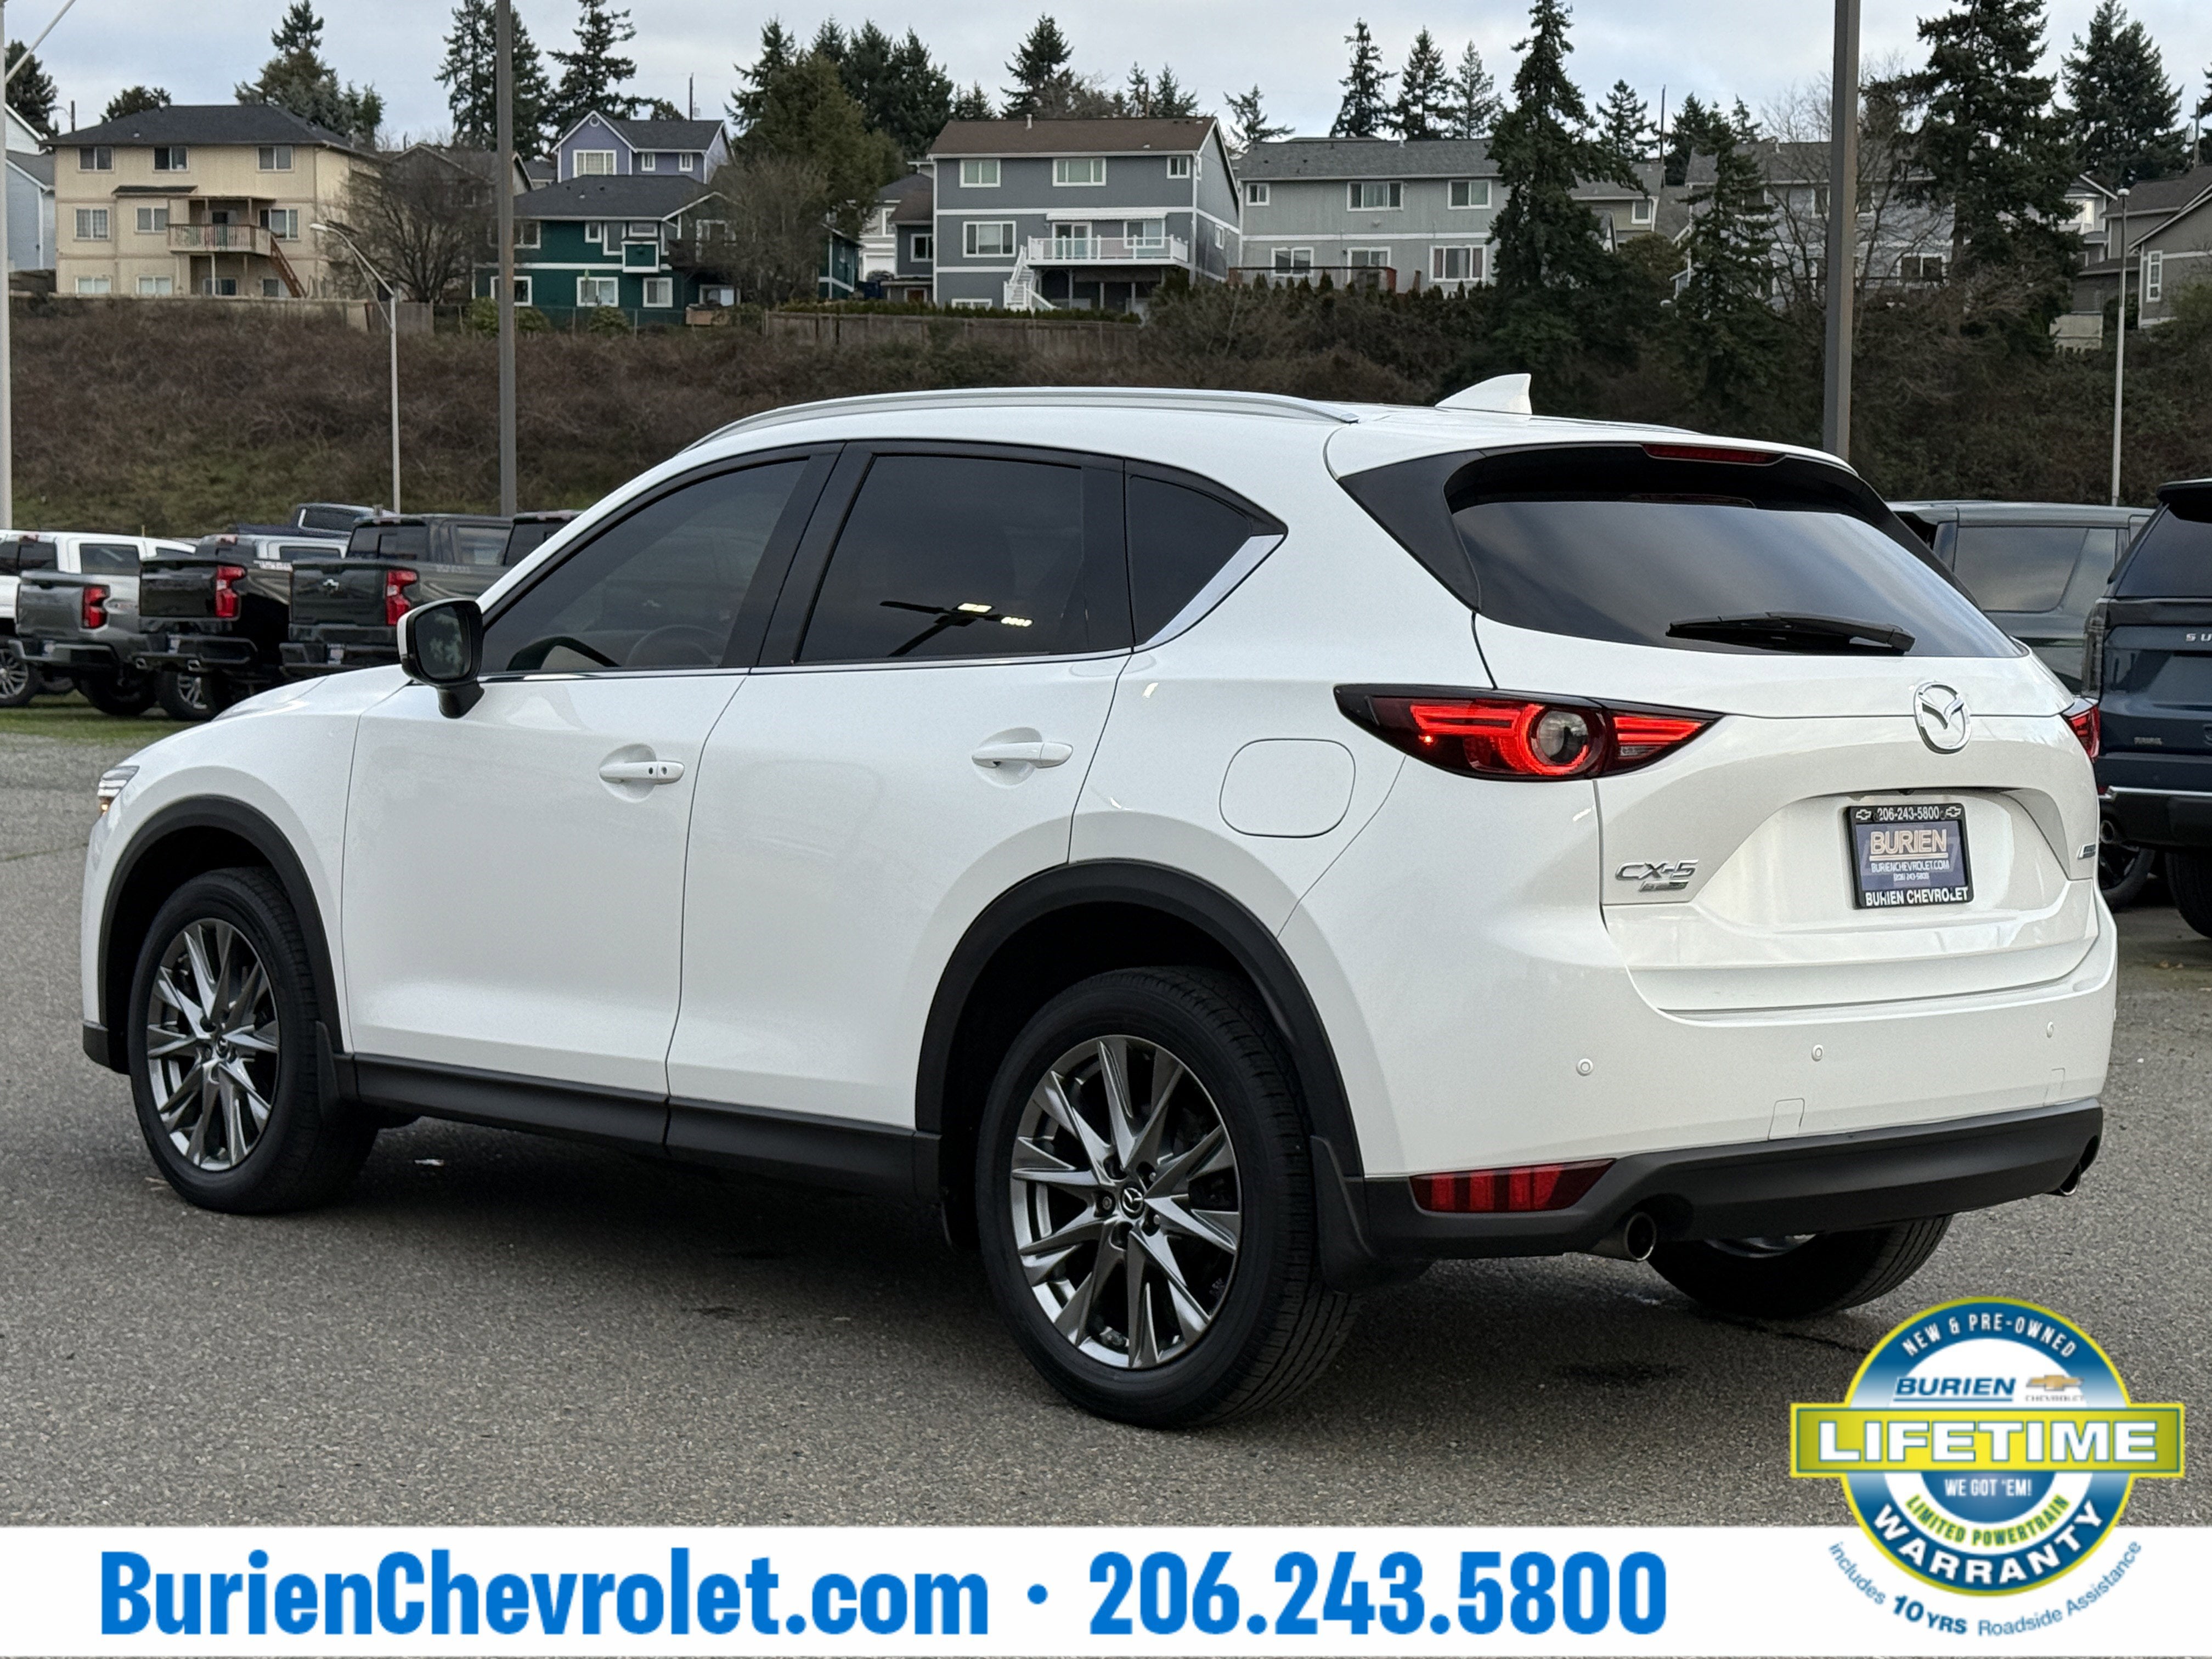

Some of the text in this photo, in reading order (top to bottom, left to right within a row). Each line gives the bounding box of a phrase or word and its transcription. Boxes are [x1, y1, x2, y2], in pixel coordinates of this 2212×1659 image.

[1876, 806, 1940, 821] 206-243-5800
[1870, 829, 1948, 855] BURIEN
[1615, 859, 1699, 881] CX-5
[1871, 859, 1950, 873] BURIENCHEVROLET.COM
[1906, 886, 1968, 904] CHEVROLET
